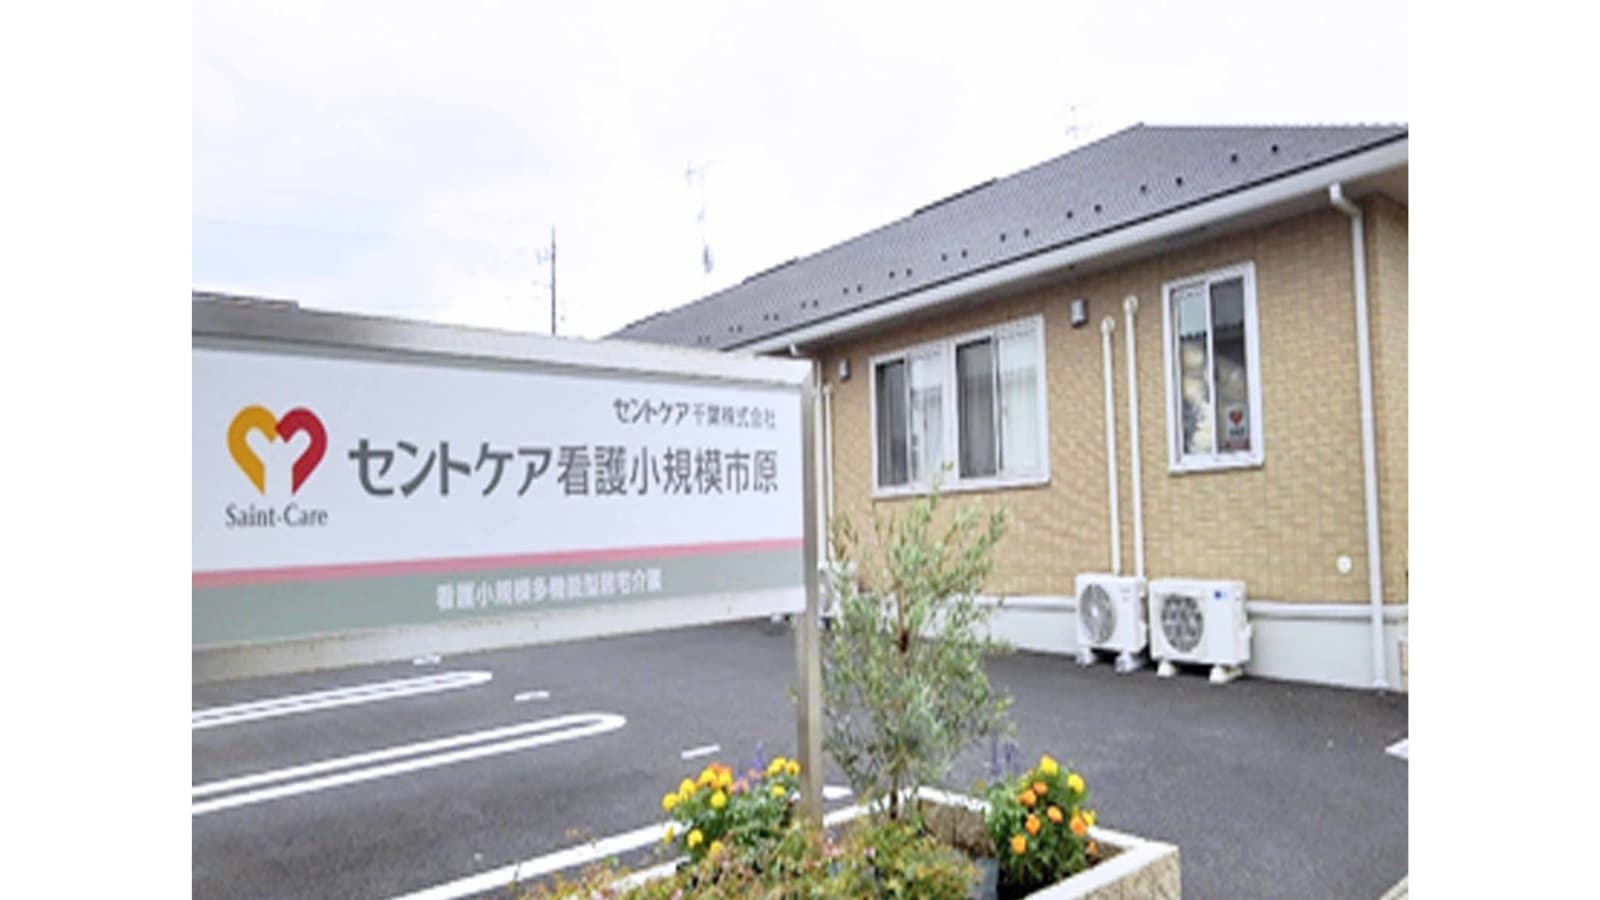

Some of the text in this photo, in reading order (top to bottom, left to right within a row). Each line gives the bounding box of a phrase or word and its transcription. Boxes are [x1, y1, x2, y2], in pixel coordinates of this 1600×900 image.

[348, 438, 779, 497] セントケア看護小規模市原
[225, 503, 329, 529] Saint-Care
